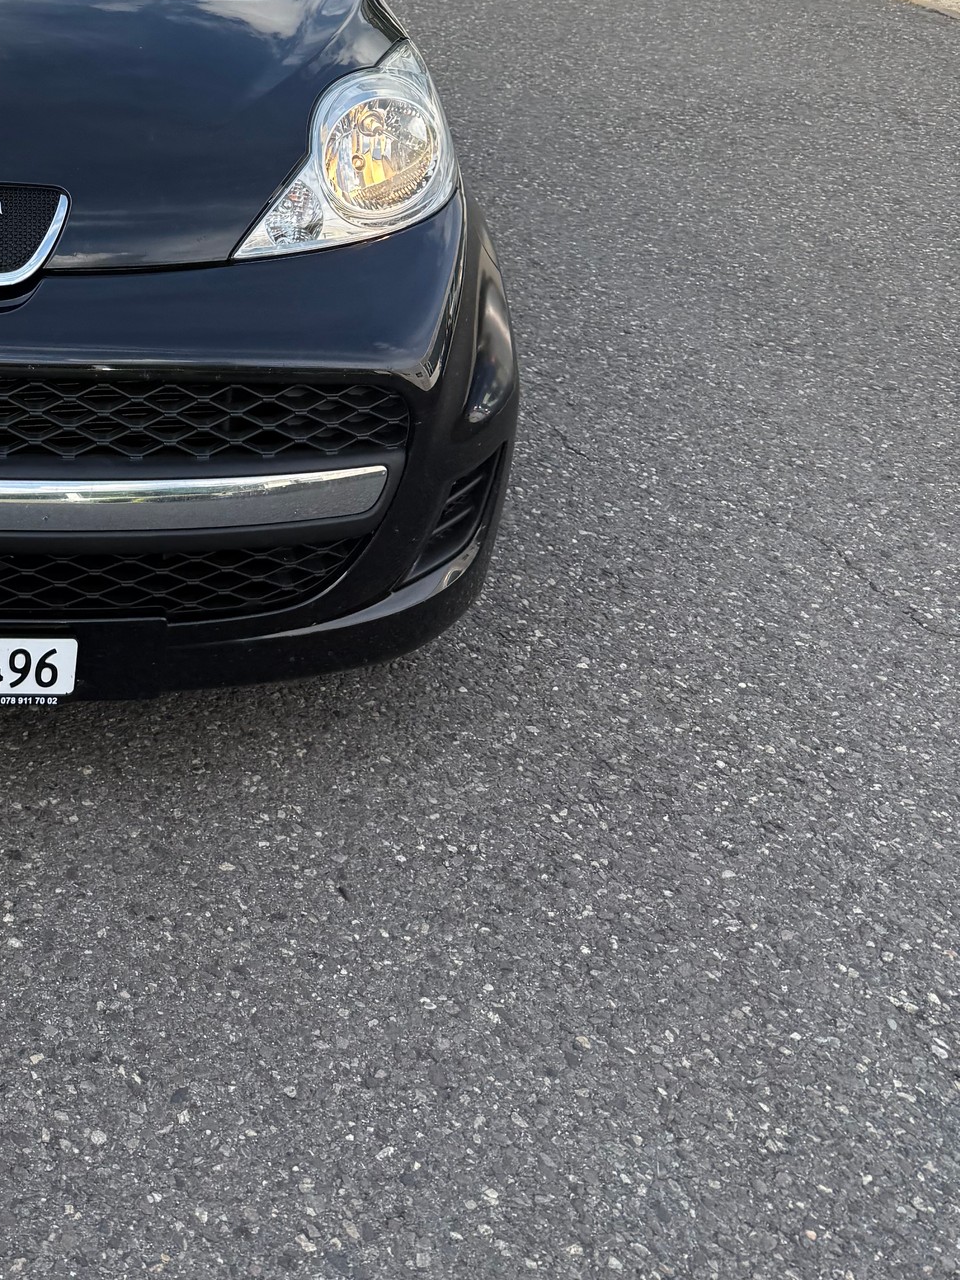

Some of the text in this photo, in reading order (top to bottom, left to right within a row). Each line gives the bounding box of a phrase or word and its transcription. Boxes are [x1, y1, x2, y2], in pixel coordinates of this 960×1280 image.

[0, 696, 16, 705] 078
[18, 696, 32, 705] 911
[35, 696, 45, 705] 70
[46, 696, 58, 705] 02
